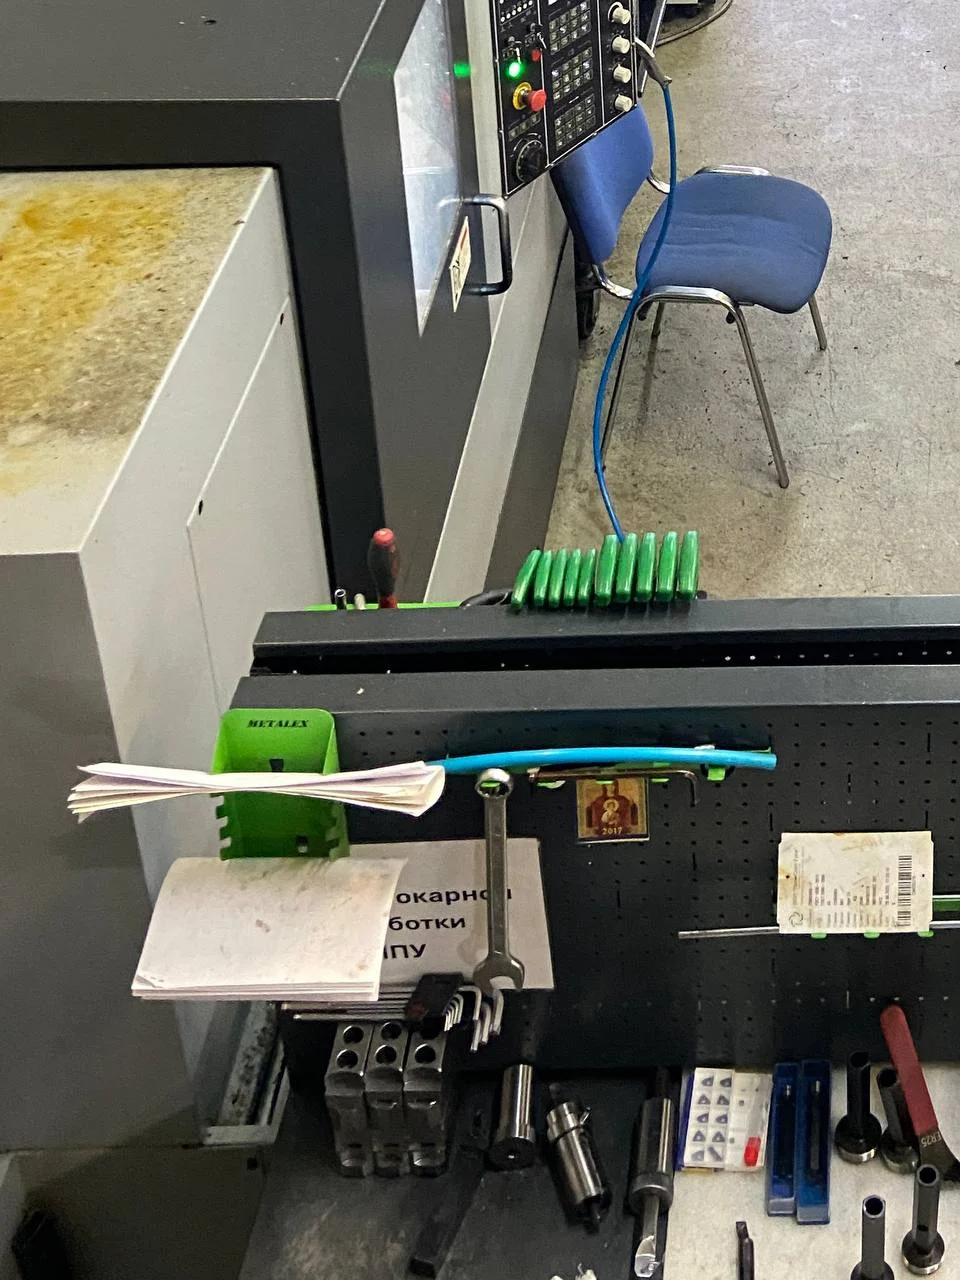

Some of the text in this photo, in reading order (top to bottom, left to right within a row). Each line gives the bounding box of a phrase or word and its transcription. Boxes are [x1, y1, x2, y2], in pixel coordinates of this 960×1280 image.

[247, 719, 309, 728] METALEX
[602, 827, 623, 835] 2017
[396, 888, 512, 906] окарно
[388, 916, 466, 931] ботки
